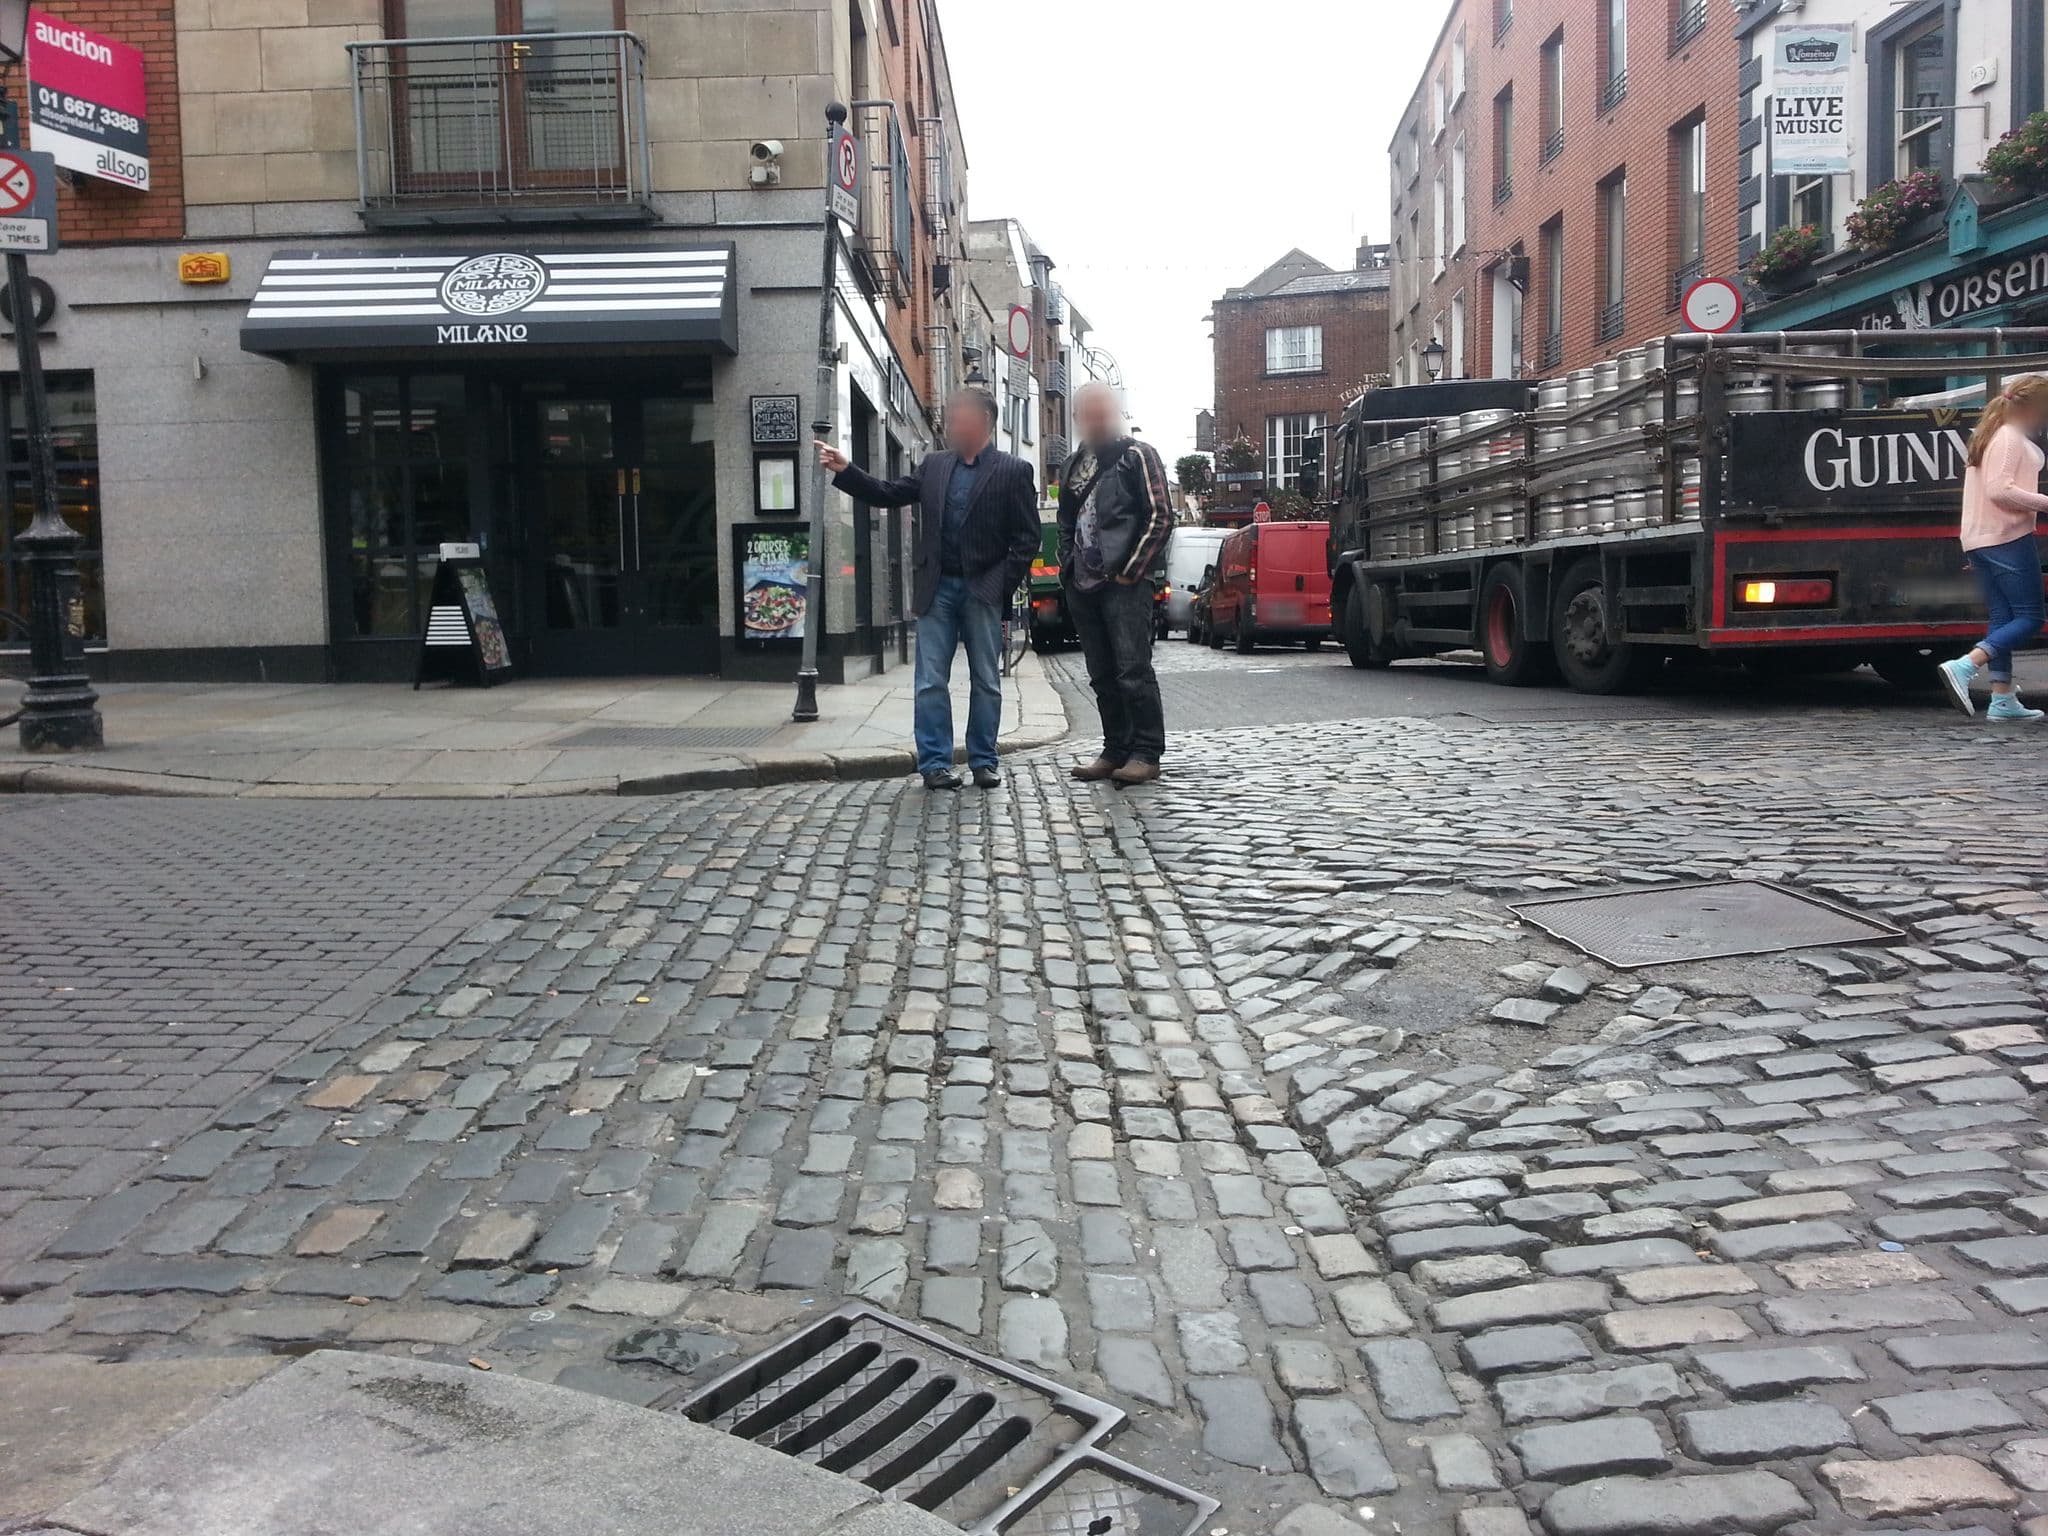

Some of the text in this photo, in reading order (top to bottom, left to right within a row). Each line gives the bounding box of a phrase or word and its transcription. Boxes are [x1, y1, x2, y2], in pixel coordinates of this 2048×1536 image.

[35, 22, 112, 66] auction
[39, 88, 139, 134] 01 667 3388
[1776, 97, 1843, 117] LIVE
[1776, 119, 1843, 134] MUSIC
[97, 150, 146, 184] allsop
[7, 234, 40, 244] TIMES
[455, 279, 530, 290] MILANO
[1861, 313, 1892, 330] The
[437, 324, 528, 343] MILANO
[1255, 511, 1270, 522] STOP
[747, 540, 789, 553] 2 COURSES
